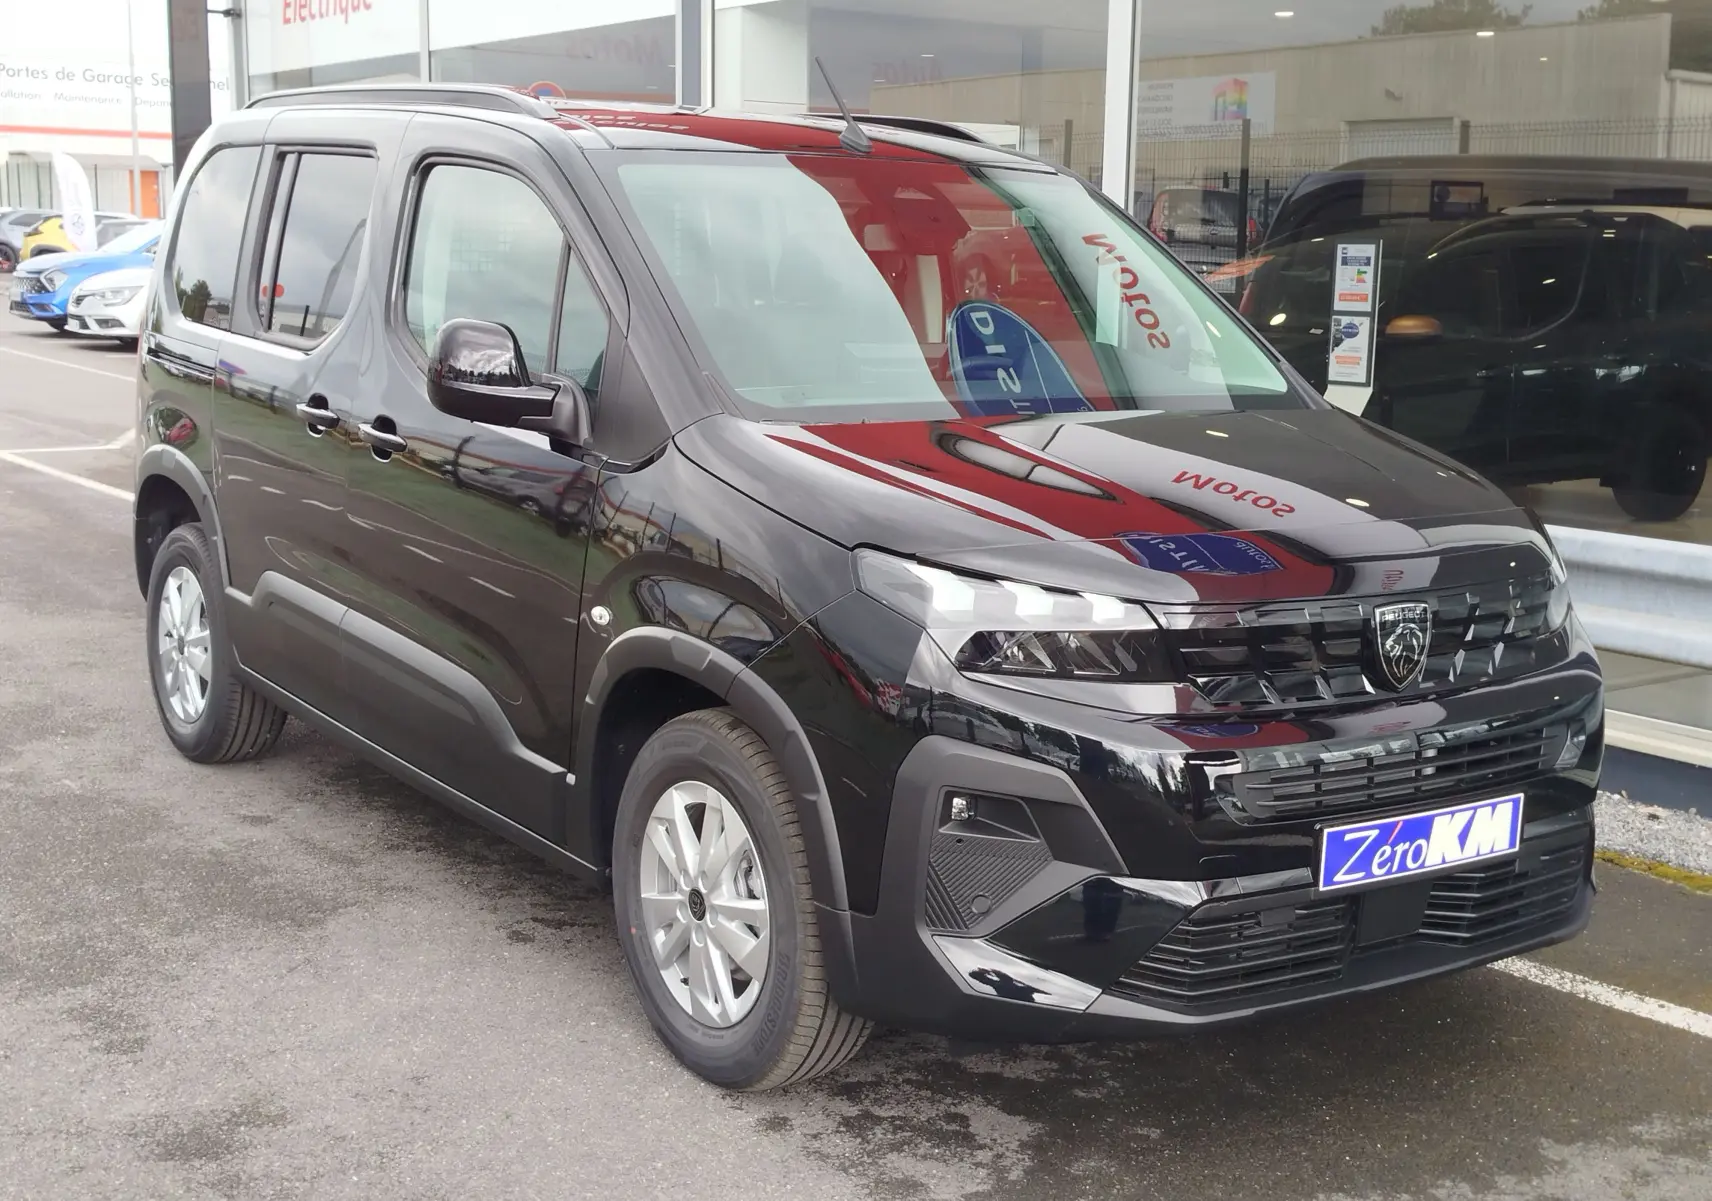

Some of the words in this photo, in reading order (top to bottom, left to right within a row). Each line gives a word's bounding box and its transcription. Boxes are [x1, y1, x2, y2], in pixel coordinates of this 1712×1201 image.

[55, 66, 76, 81] de
[82, 68, 144, 88] Garage
[1381, 610, 1426, 623] PEUGEOT
